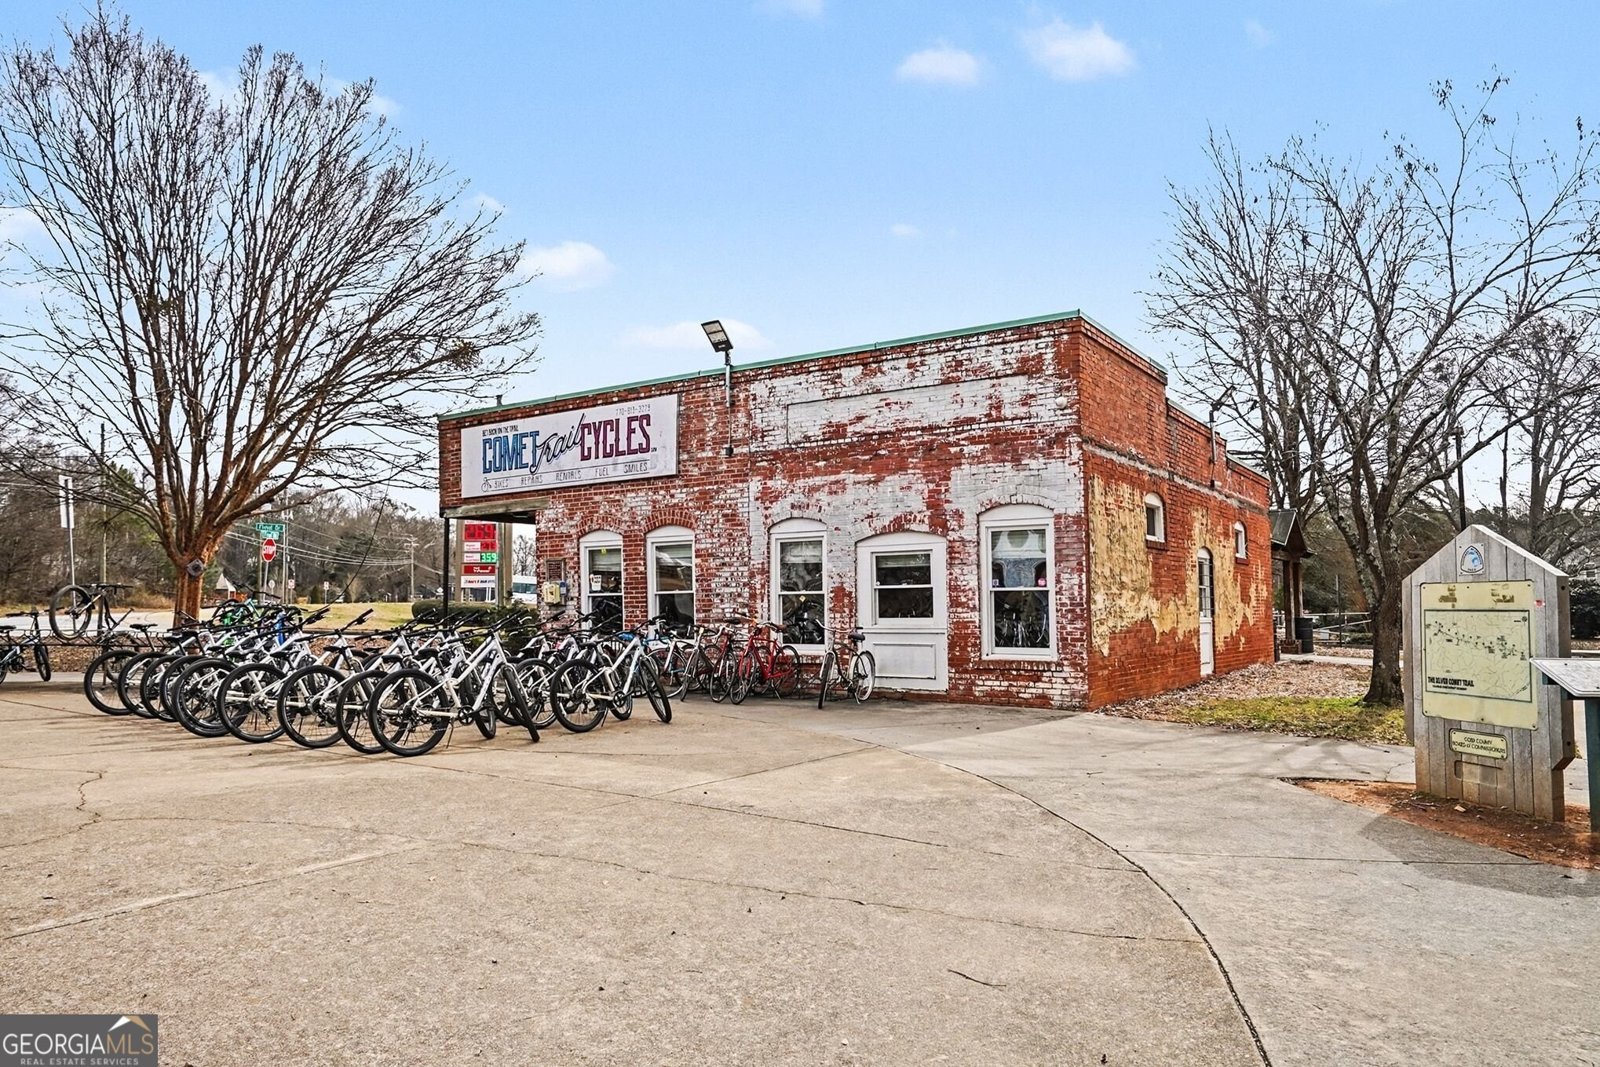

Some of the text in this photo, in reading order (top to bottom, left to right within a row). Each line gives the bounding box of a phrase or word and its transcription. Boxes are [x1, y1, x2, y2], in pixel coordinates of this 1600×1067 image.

[482, 412, 651, 475] COMET Trail CYCLES
[494, 478, 509, 489] BIKES
[520, 474, 543, 485] REPAIRS
[595, 466, 609, 477] FUEL
[623, 462, 648, 474] SMILES
[263, 545, 276, 555] STOP
[1449, 678, 1462, 686] COMET
[1462, 679, 1475, 687] TRAIL
